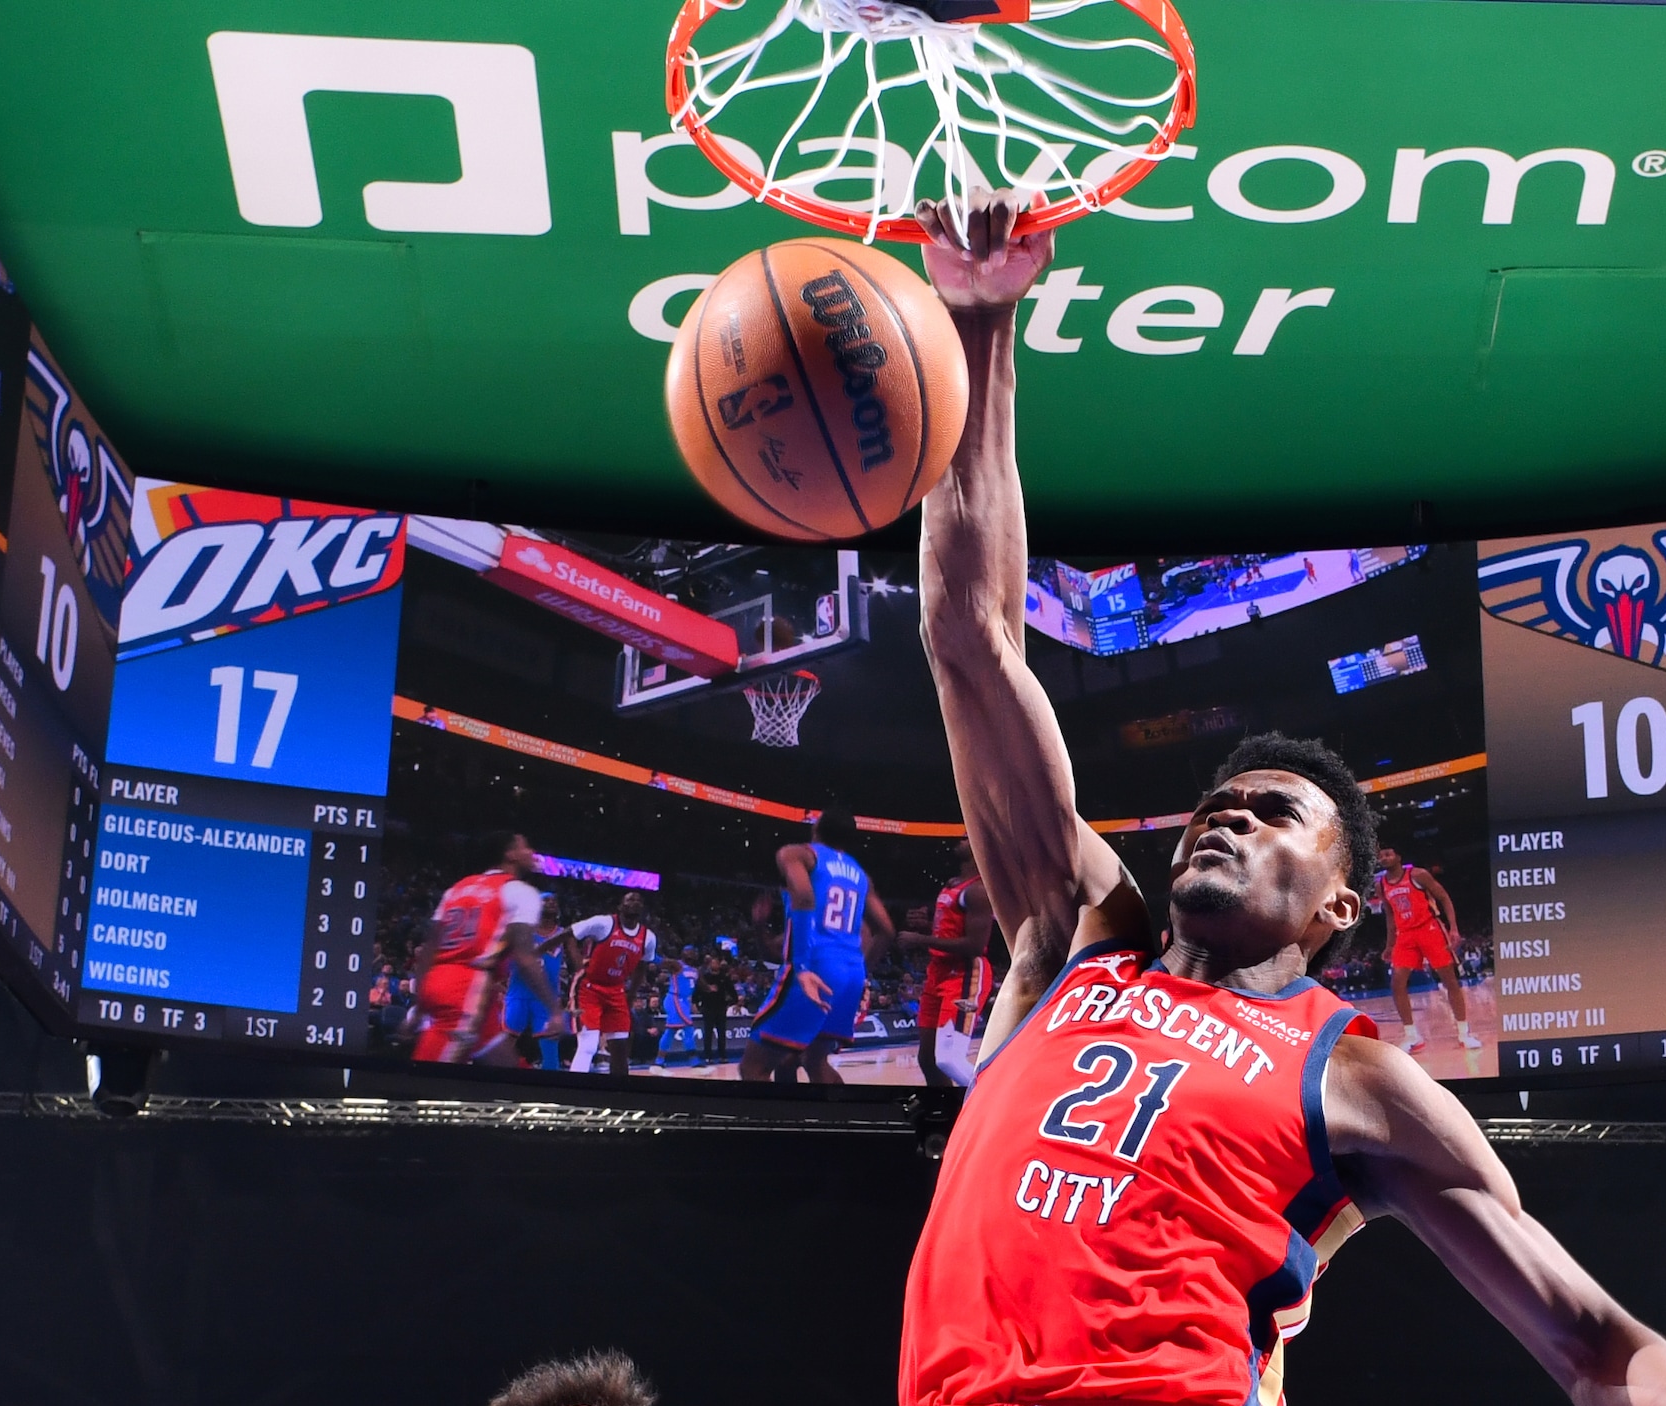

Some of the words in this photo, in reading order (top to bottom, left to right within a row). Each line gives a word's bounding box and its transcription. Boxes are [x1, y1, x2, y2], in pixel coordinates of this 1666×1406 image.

[628, 266, 1335, 356] cter
[800, 269, 895, 474] Wilson
[118, 517, 401, 645] OKC
[554, 562, 662, 623] StateFarm
[1089, 563, 1136, 597] OKC
[1107, 593, 1126, 612] 15
[37, 555, 79, 692] 10
[210, 665, 300, 769] 17
[111, 778, 179, 806] PLAYER
[314, 803, 348, 826] PTS
[355, 809, 376, 829] FL
[104, 814, 306, 858] GILGEOUS-ALEXANDER
[323, 842, 335, 860] 2
[360, 845, 367, 863] 1
[1498, 830, 1564, 853] PLAYER
[100, 850, 150, 874] DORT
[321, 878, 332, 896] 3
[353, 881, 365, 900] 0
[1497, 867, 1556, 889] GREEN
[96, 887, 198, 918] HOLMGREN
[318, 915, 329, 933] 3
[351, 917, 363, 936] 0
[827, 890, 860, 932] 21
[1498, 902, 1566, 924] REEVES
[93, 924, 167, 951] CARUSO
[315, 951, 326, 969] 0
[348, 954, 360, 972] 0
[1499, 939, 1551, 960] MISSI
[88, 960, 171, 990] WIGGINS
[312, 988, 324, 1006] 2
[345, 991, 357, 1009] 0
[1501, 973, 1582, 996] HAWKINS
[98, 999, 122, 1021] TO
[133, 1003, 146, 1023] 6
[161, 1007, 184, 1029] TF
[194, 1012, 206, 1031] 3
[244, 1016, 278, 1039] 1ST
[306, 1025, 345, 1046] 3:41
[1046, 984, 1274, 1086] CRESCENT
[1235, 999, 1313, 1042] NEWAGE
[1237, 1011, 1299, 1047] PRODUCTS
[1502, 1009, 1580, 1033] MURPHY
[1585, 1007, 1606, 1026] III
[1516, 1049, 1539, 1069] TO
[1550, 1047, 1563, 1067] 6
[1577, 1044, 1600, 1065] TF
[1613, 1042, 1622, 1062] 1
[1038, 1041, 1192, 1163] 21
[1015, 1160, 1136, 1226] CITY
